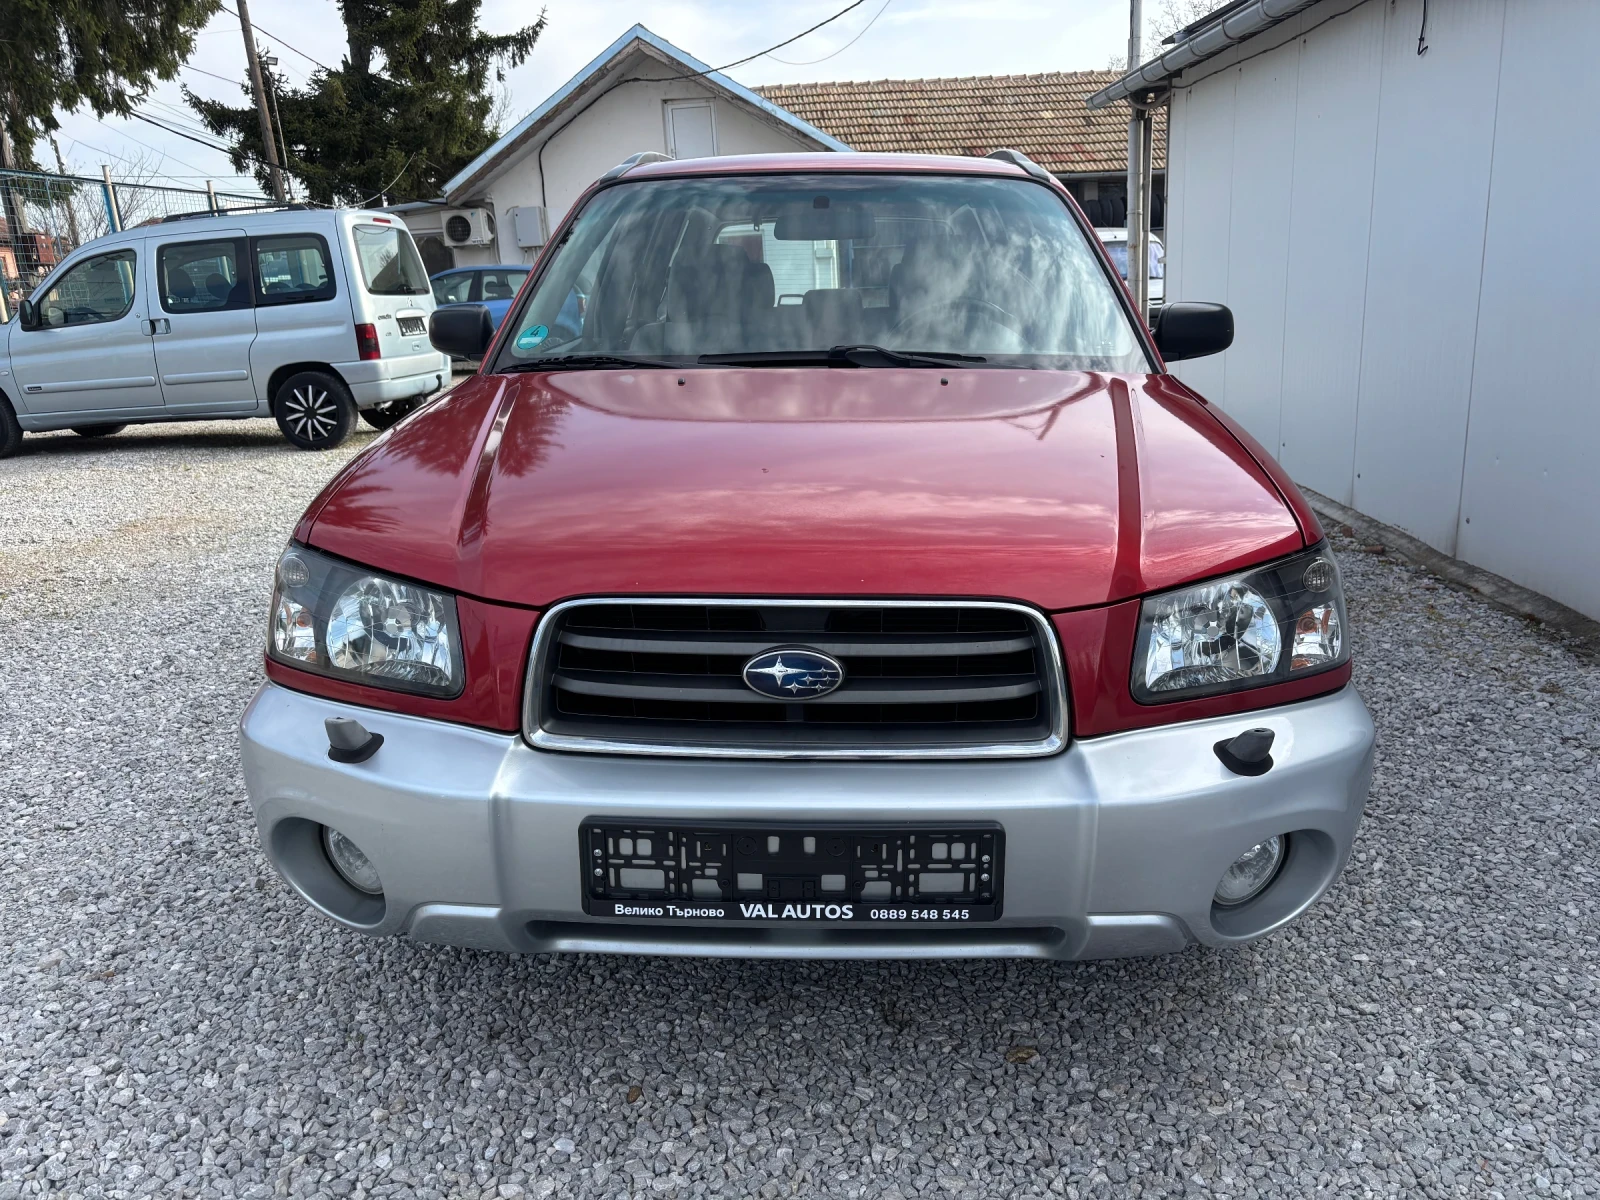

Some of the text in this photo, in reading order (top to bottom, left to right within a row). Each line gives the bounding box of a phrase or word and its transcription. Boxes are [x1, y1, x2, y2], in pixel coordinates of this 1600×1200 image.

[530, 325, 541, 337] 4
[614, 903, 725, 919] Велико Търново
[739, 902, 854, 920] VAL AUTOS
[870, 908, 970, 920] 0889 548 545
